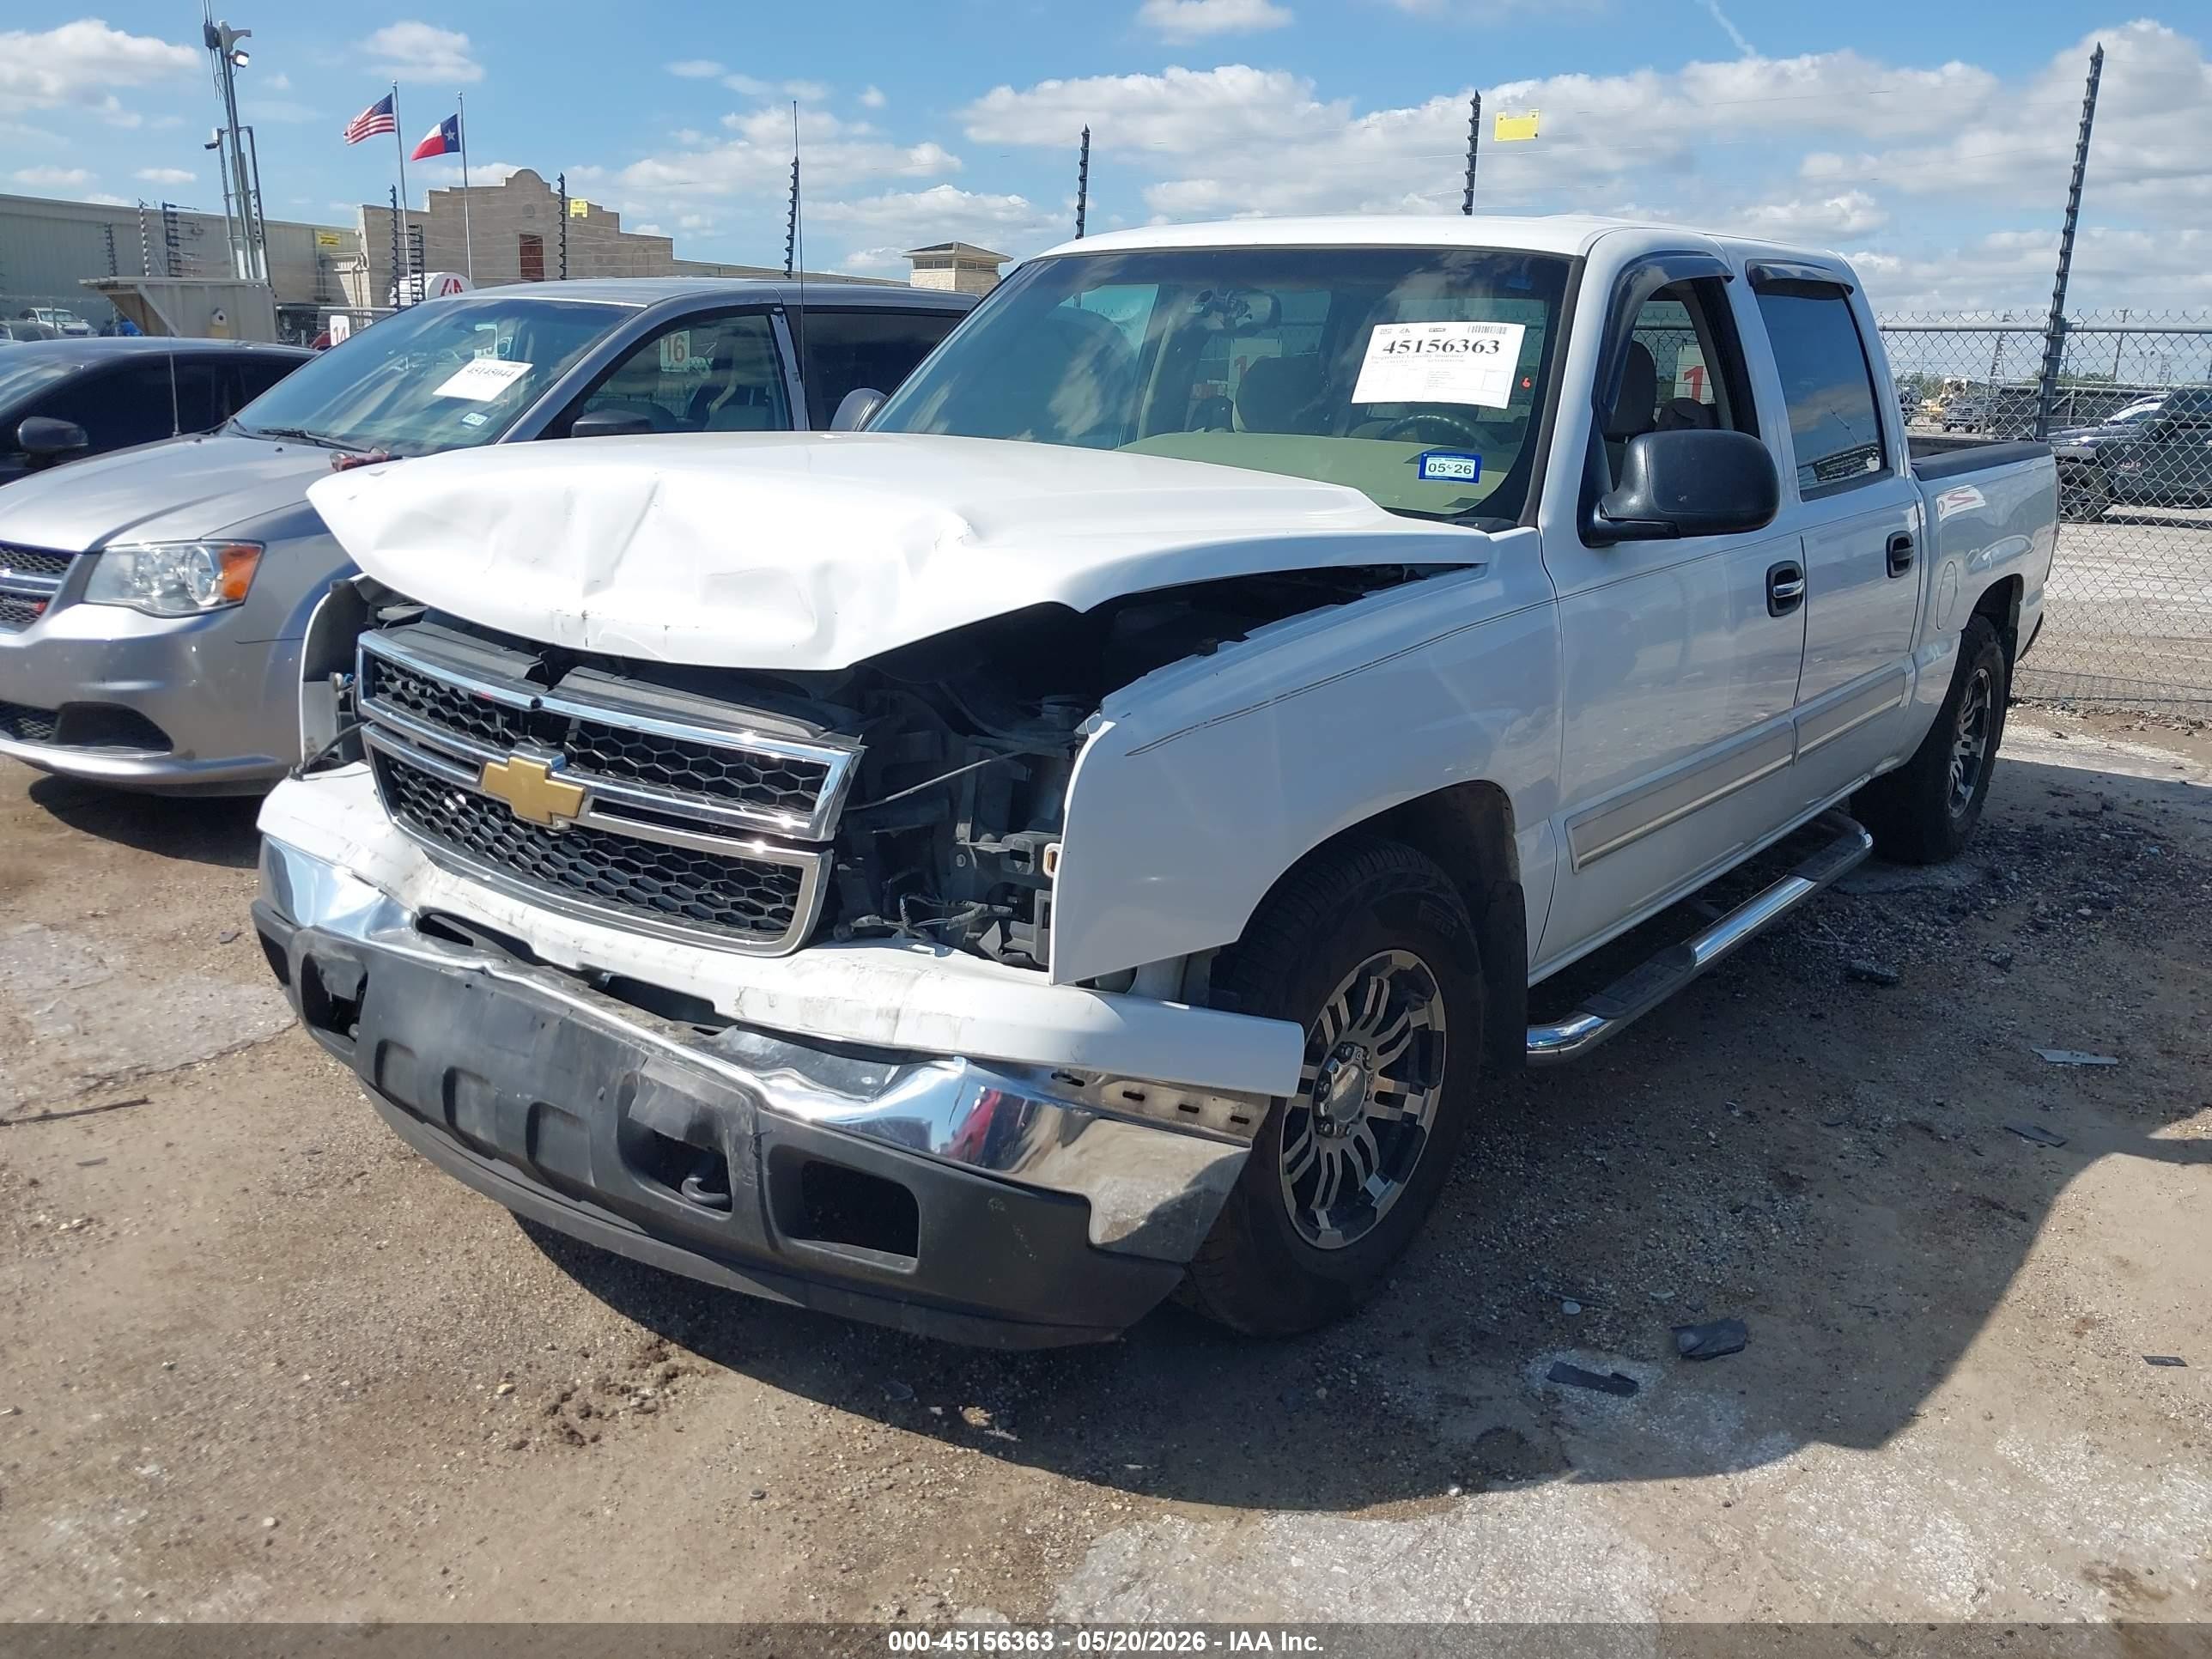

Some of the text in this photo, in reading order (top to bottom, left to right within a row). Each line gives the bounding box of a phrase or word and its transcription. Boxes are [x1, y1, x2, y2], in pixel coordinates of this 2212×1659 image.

[664, 334, 685, 363] 16
[1382, 337, 1501, 355] 45156363
[1428, 463, 1472, 475] 05 26
